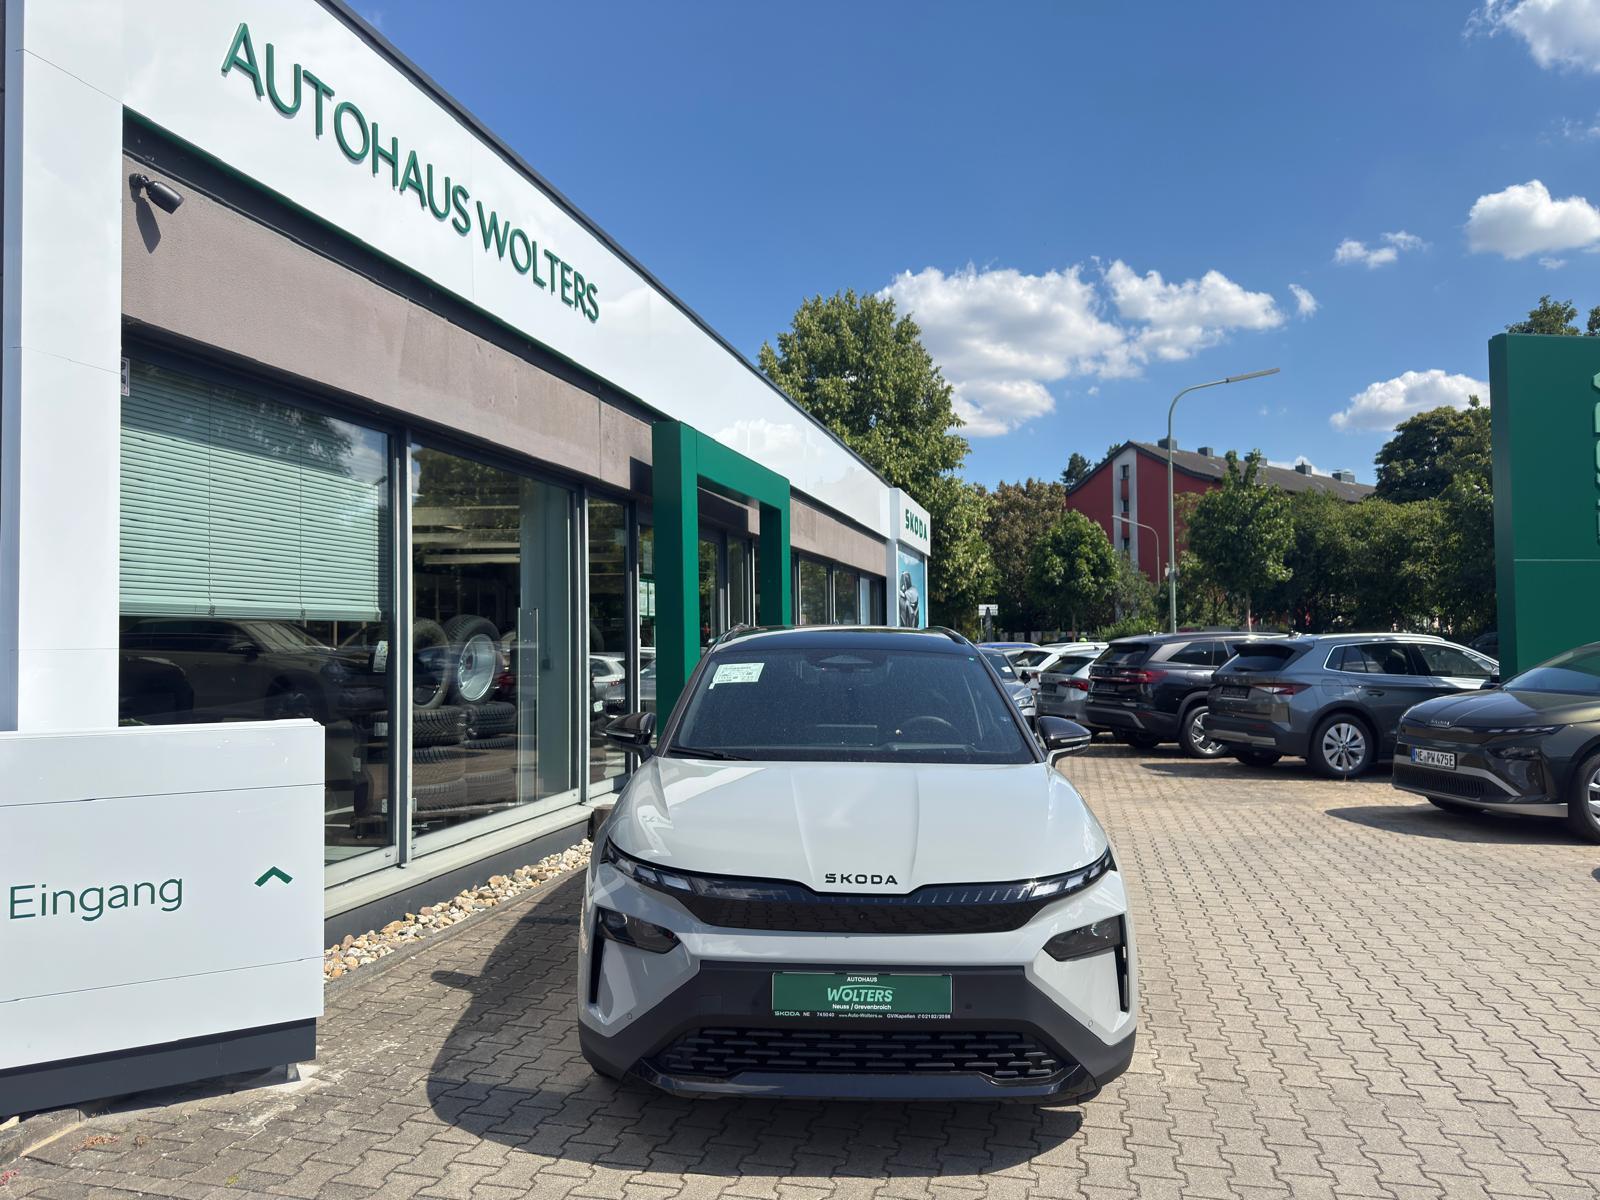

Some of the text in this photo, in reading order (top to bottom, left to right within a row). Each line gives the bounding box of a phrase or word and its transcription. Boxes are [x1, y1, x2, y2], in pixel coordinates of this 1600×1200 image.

[221, 22, 600, 322] AUTOHAUS WOLTERS
[1436, 753, 1454, 767] 475E
[9, 878, 183, 922] Eingang
[827, 985, 894, 1002] WOLTERS
[854, 1003, 892, 1011] Grevenbroich
